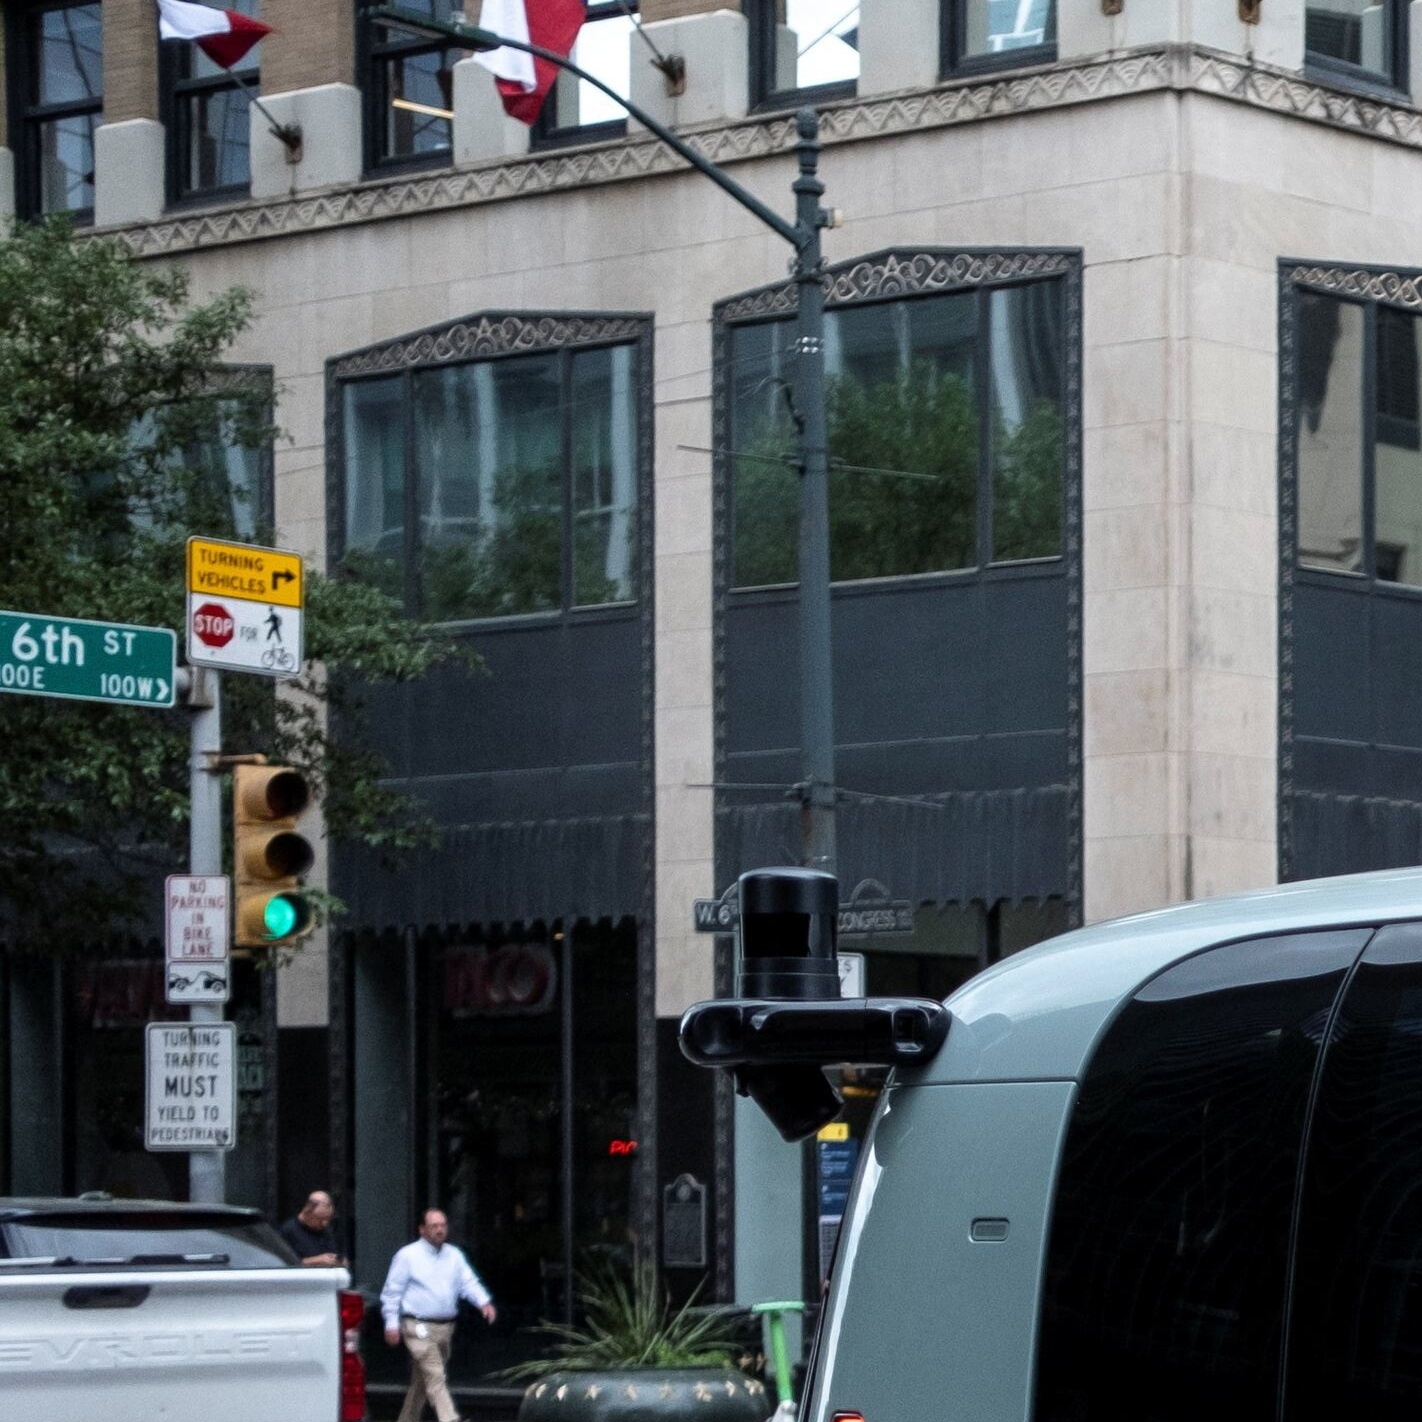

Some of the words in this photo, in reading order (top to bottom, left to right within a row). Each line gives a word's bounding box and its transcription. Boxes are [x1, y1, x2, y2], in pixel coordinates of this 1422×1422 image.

[199, 548, 264, 572] TURNING
[198, 570, 266, 595] VEHICLES
[194, 613, 232, 637] STOP
[11, 621, 85, 667] 6th
[103, 629, 136, 656] ST
[0, 662, 45, 689] 00E
[101, 672, 153, 700] 100W
[190, 880, 206, 893] NO
[171, 895, 225, 909] PARKING
[184, 927, 212, 940] BIKE
[182, 942, 213, 957] LANE
[163, 1030, 221, 1047] TURNING
[164, 1052, 219, 1067] TRAFFIC
[164, 1075, 218, 1098] MUST
[158, 1105, 195, 1121] YIELD
[203, 1105, 219, 1121] TO
[151, 1127, 229, 1142] PEDESTRIANS
